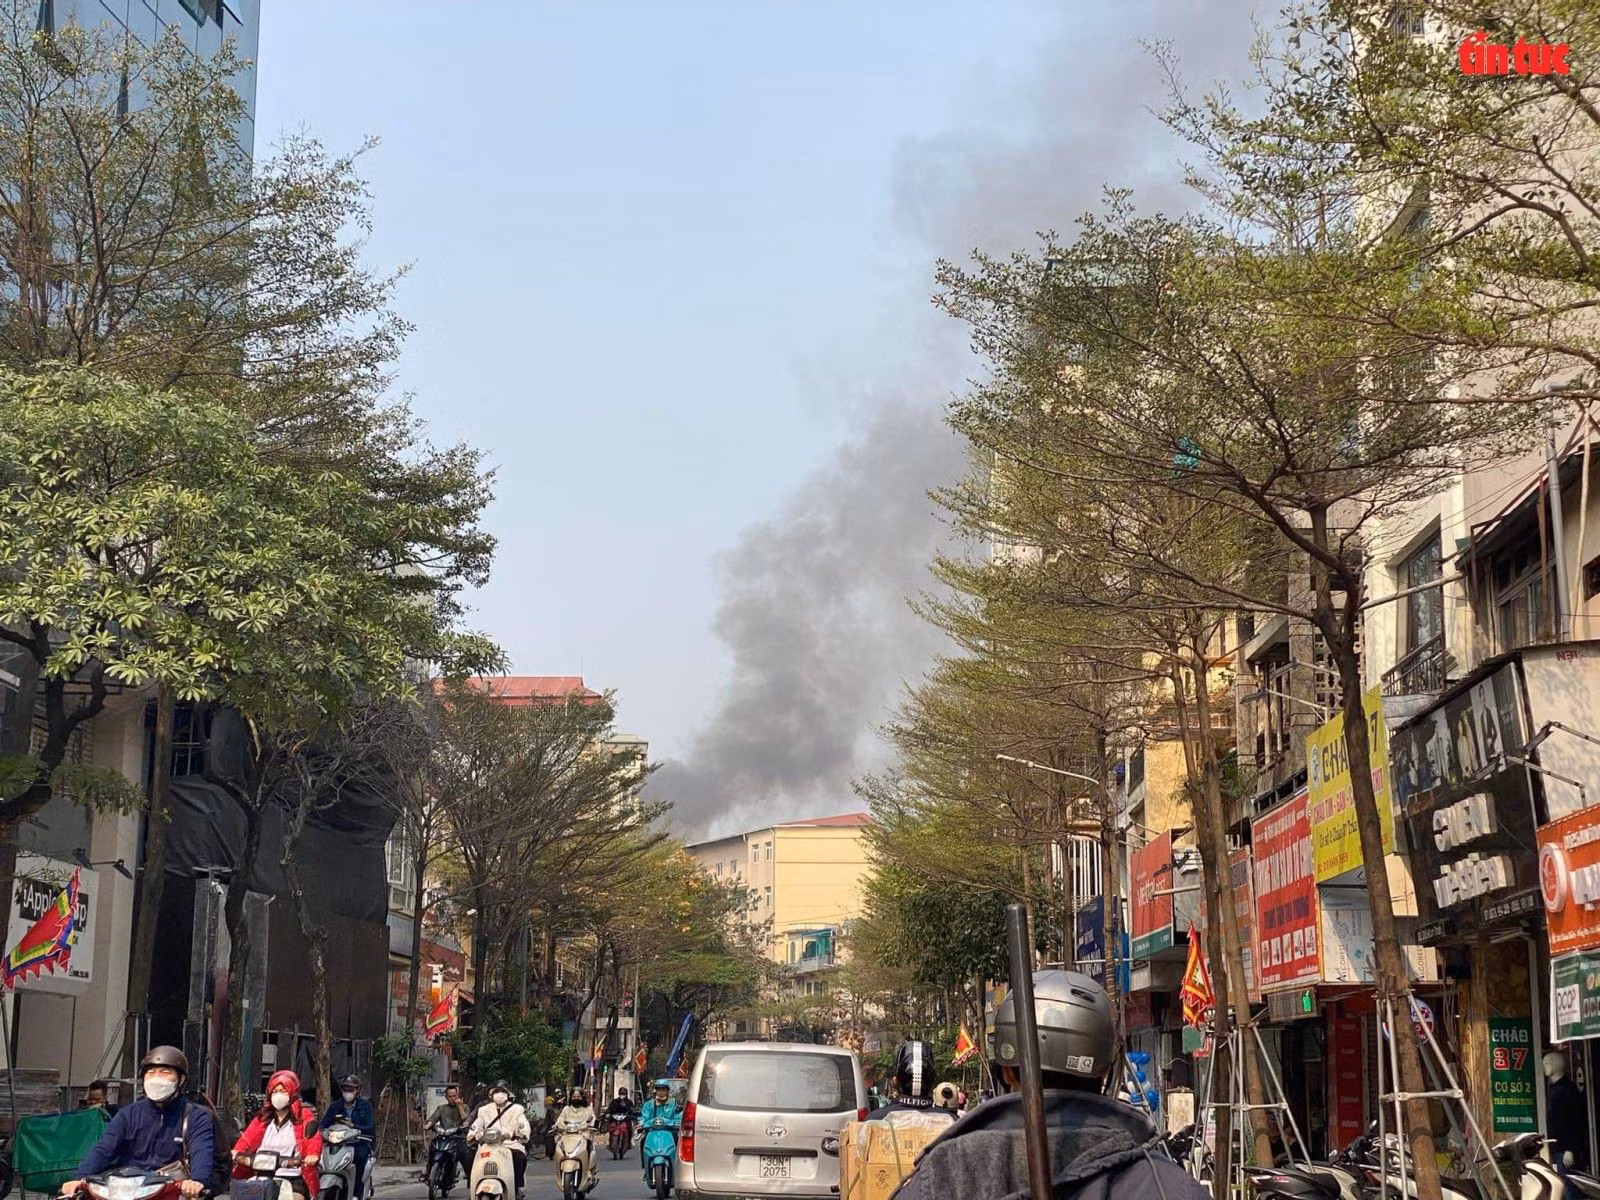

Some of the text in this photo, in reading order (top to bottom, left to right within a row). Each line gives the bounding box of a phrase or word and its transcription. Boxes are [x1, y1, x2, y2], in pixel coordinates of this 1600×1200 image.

[1492, 1026, 1529, 1043] CHÁO
[1493, 1047, 1529, 1070] 37
[1525, 1082, 1531, 1093] 2
[766, 1156, 784, 1167] 30N
[763, 1166, 787, 1177] 2075
